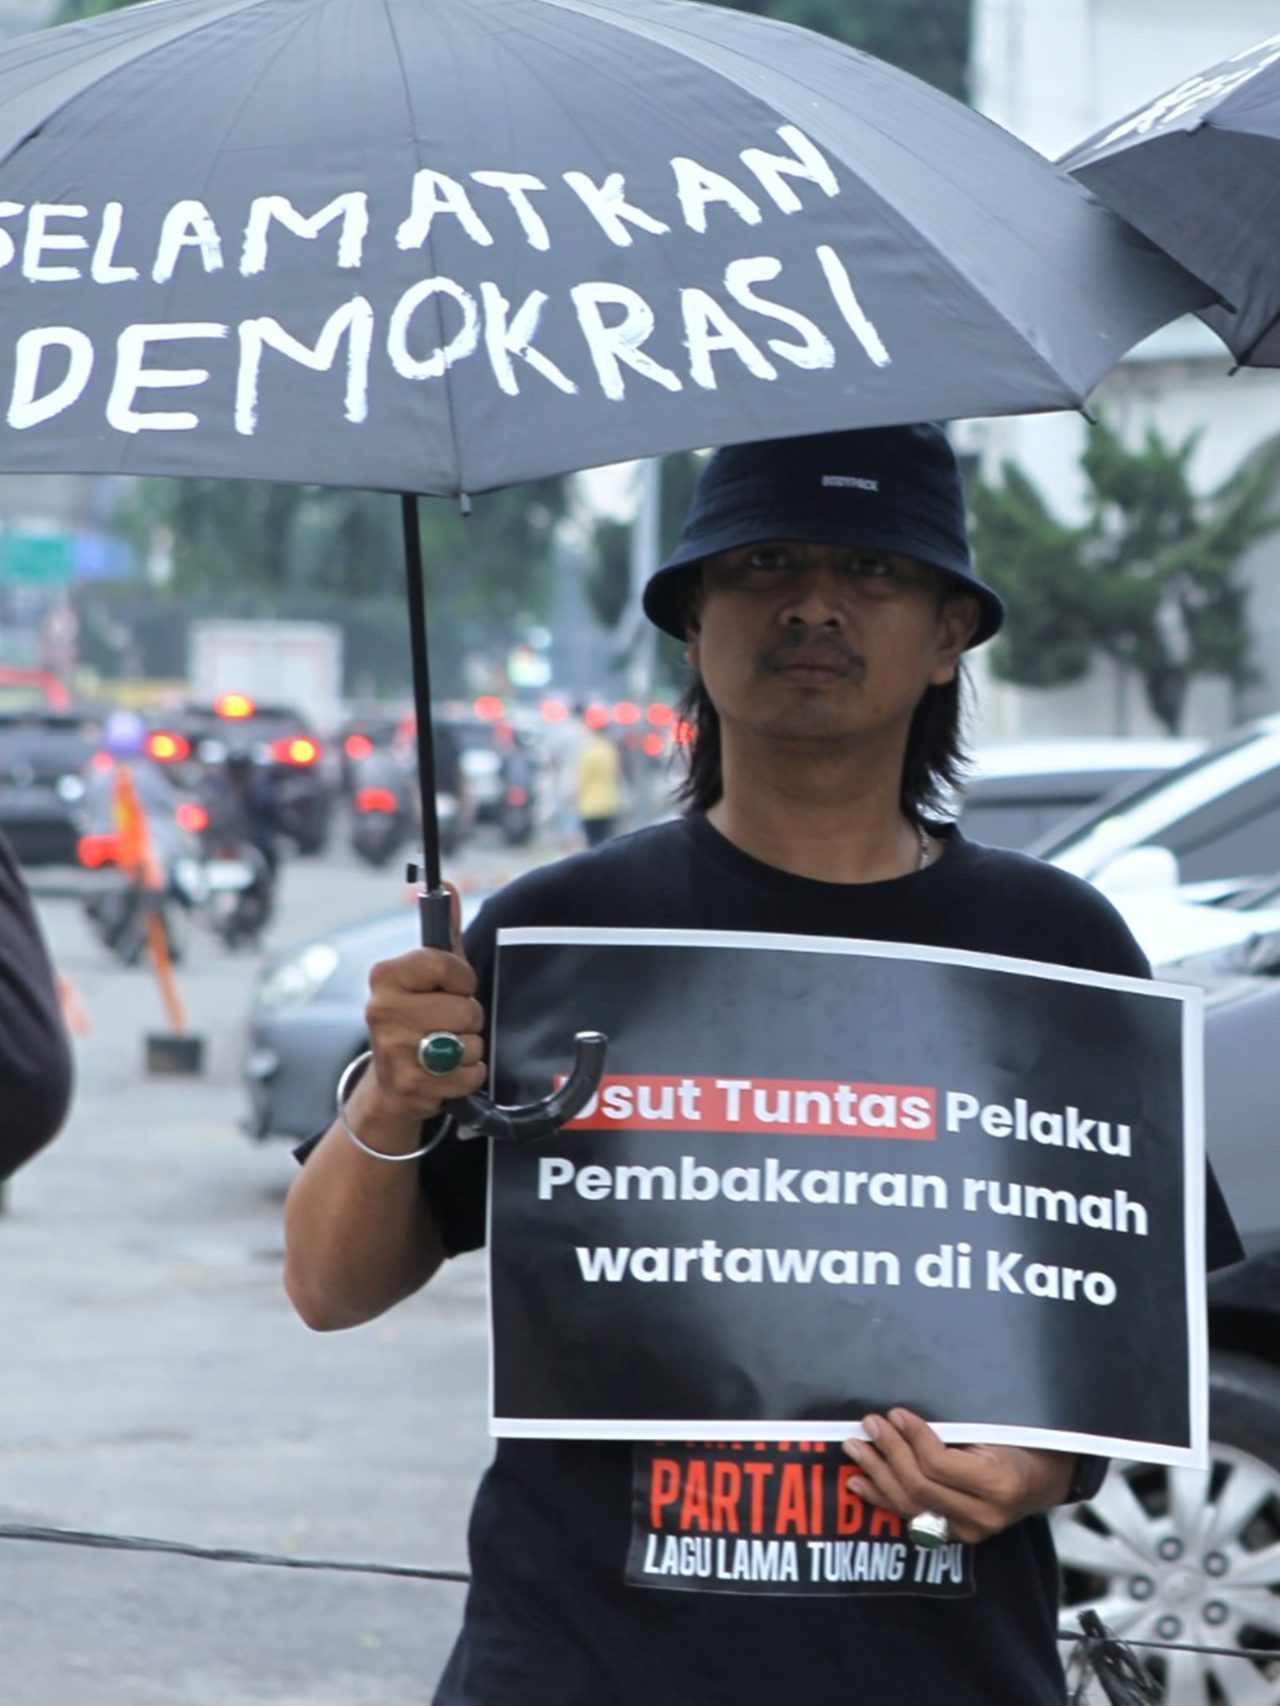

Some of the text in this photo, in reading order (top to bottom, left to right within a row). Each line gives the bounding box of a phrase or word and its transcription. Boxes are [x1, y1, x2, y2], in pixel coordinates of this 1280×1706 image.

[7, 246, 892, 436] DEMOKRASI
[715, 1080, 932, 1130] Tuntas
[946, 1092, 1131, 1157] Pelaku
[539, 1156, 1147, 1235] Pembakaran rumah
[577, 1240, 1117, 1306] wartawan di Karo
[650, 1458, 824, 1536] PARTAI
[643, 1533, 963, 1584] LAGU LAMA TUKANG TIPU
